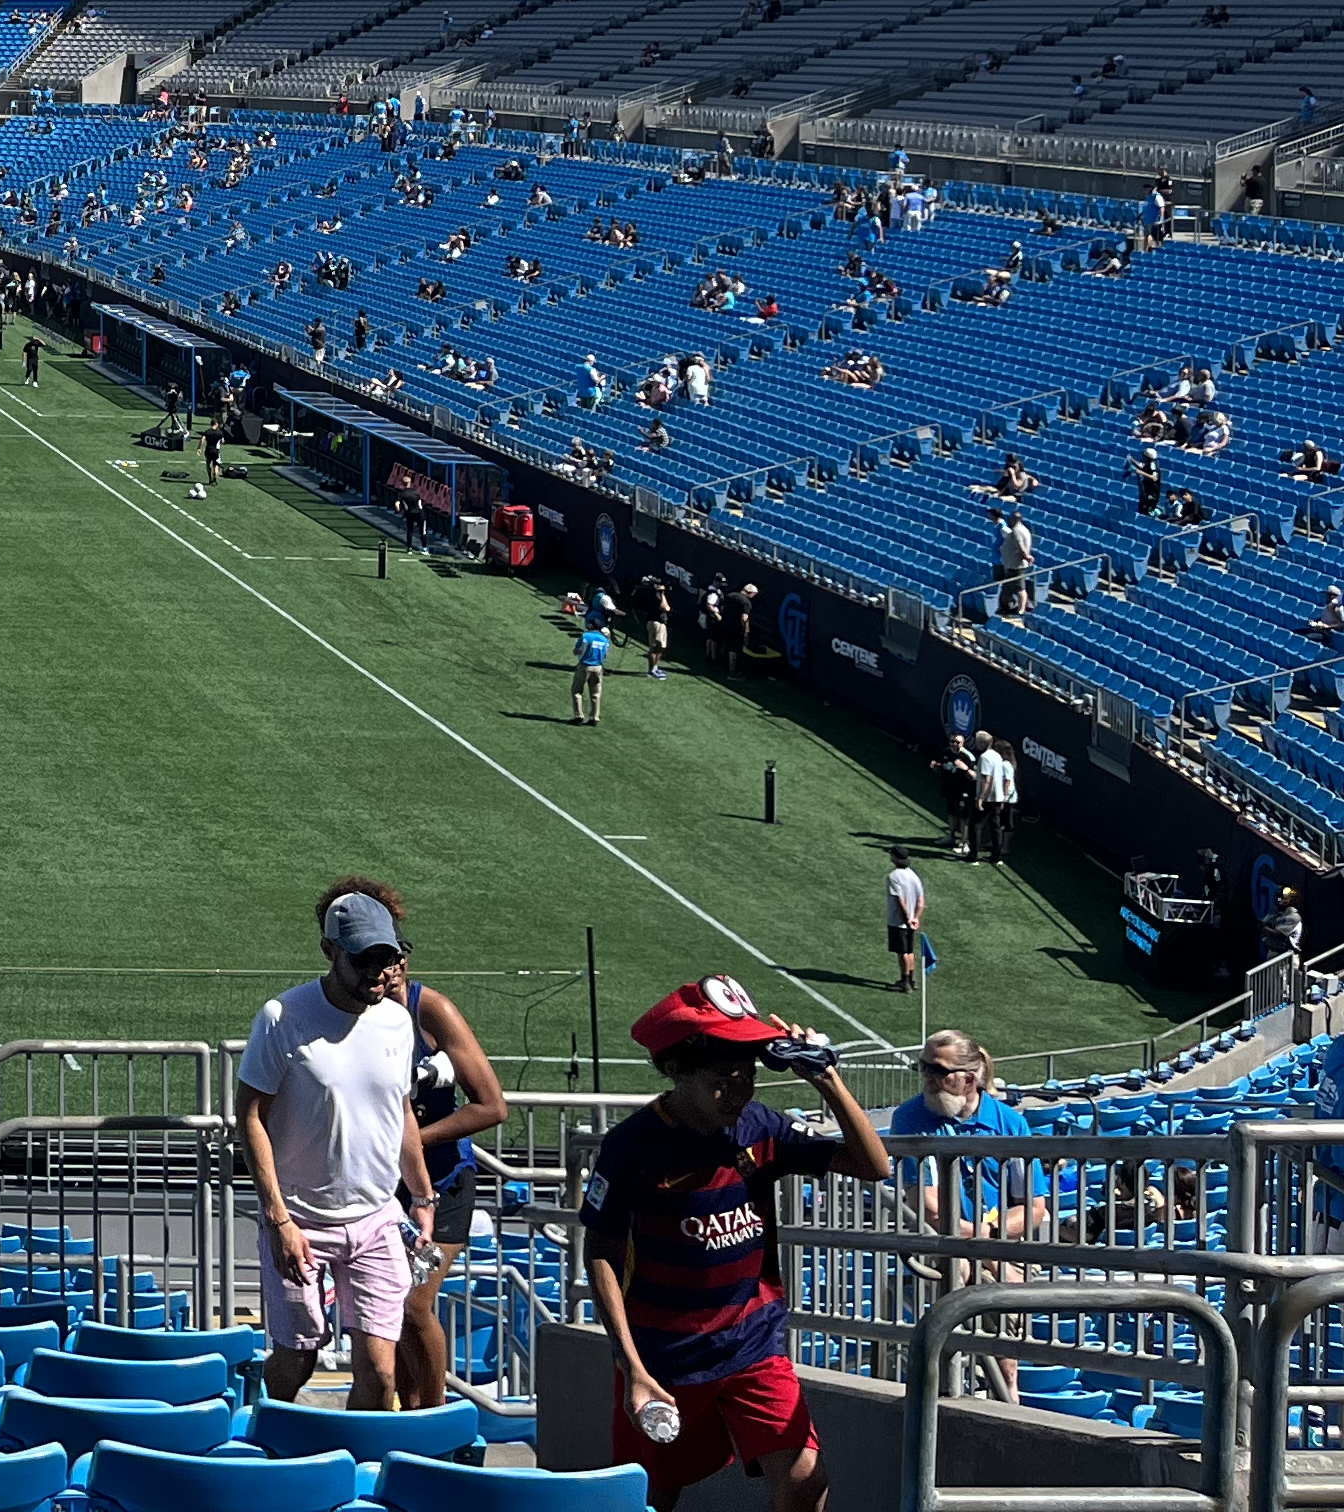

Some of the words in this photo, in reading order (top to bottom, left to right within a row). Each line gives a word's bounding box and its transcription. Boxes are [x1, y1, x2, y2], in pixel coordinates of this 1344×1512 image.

[831, 638, 879, 669] CENTENE
[1023, 737, 1067, 774] CENTENE
[680, 1202, 762, 1242] QATAR
[705, 1221, 765, 1251] AIRWAYS
